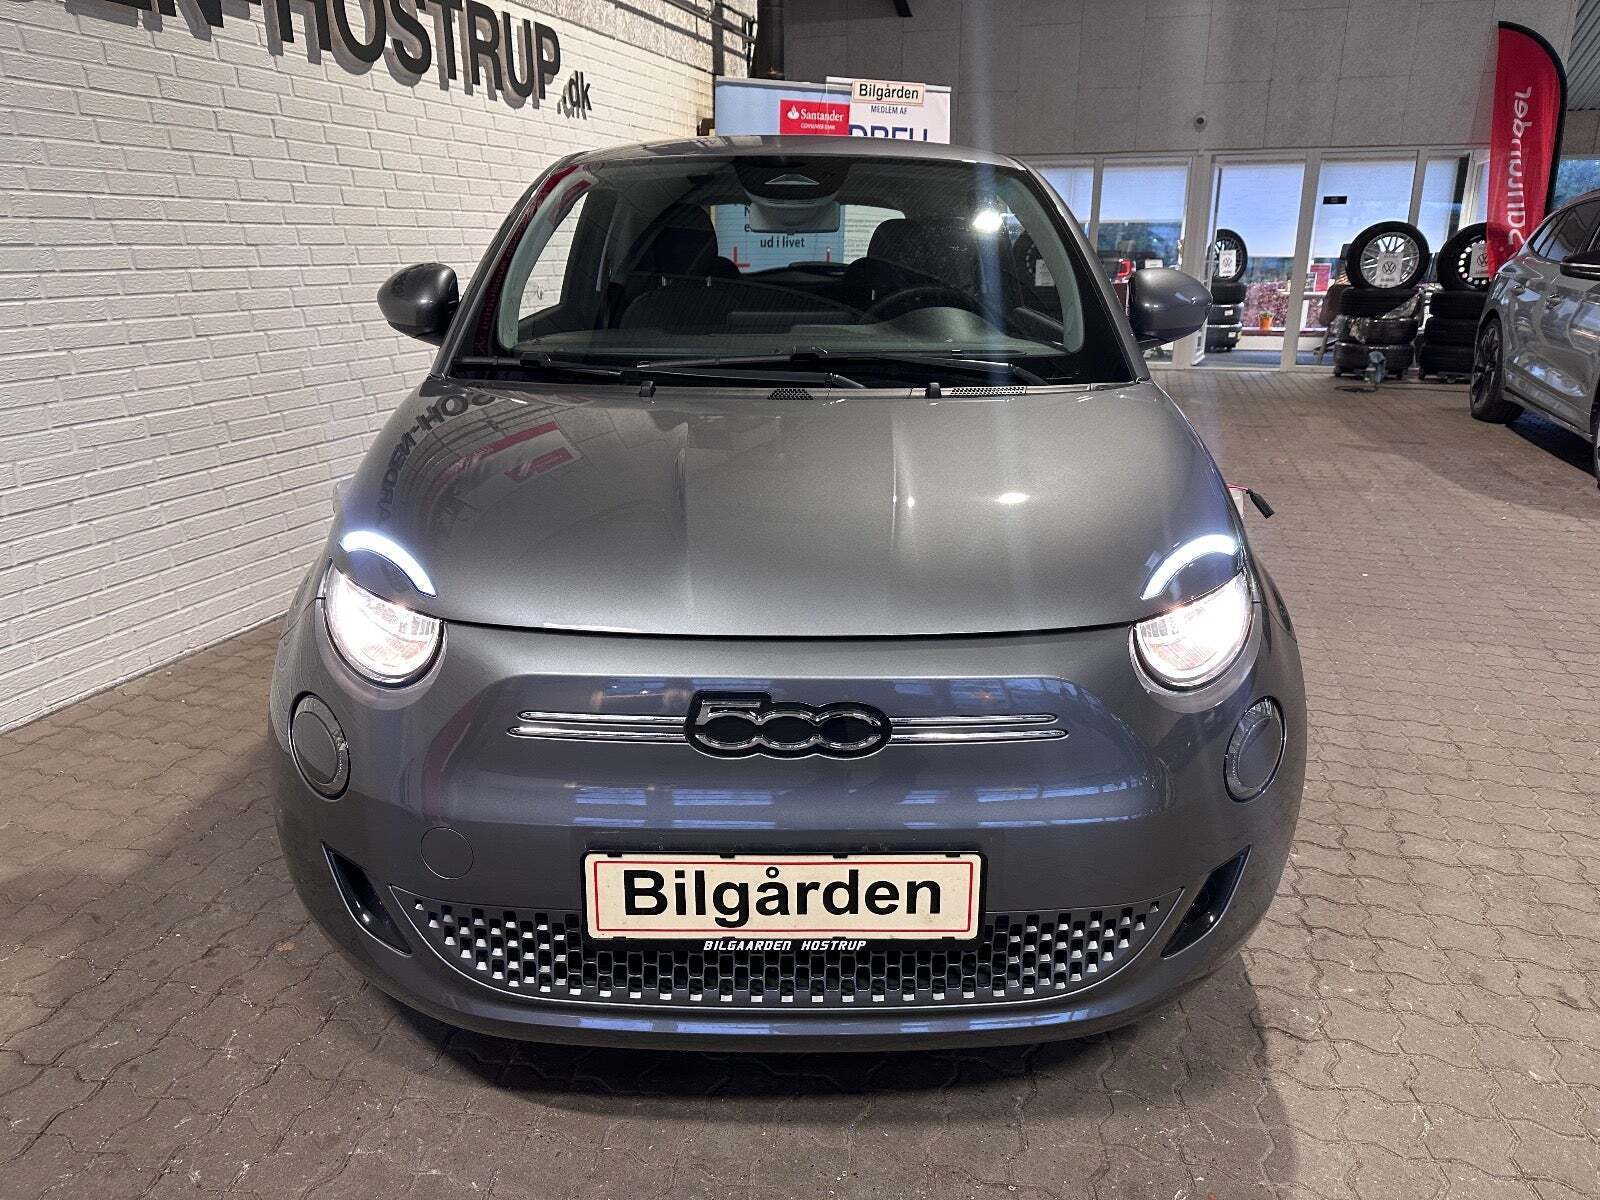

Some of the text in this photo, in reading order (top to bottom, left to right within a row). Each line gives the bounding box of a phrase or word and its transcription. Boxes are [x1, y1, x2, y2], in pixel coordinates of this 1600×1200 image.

[859, 83, 919, 101] Bilgården
[800, 108, 844, 122] Santander
[870, 105, 898, 115] MEDLEM
[760, 235, 805, 248] ud i livet
[693, 697, 887, 752] 500
[622, 866, 942, 929] Bilgården
[703, 939, 867, 951] BILGAARDEN HOSTRUP
